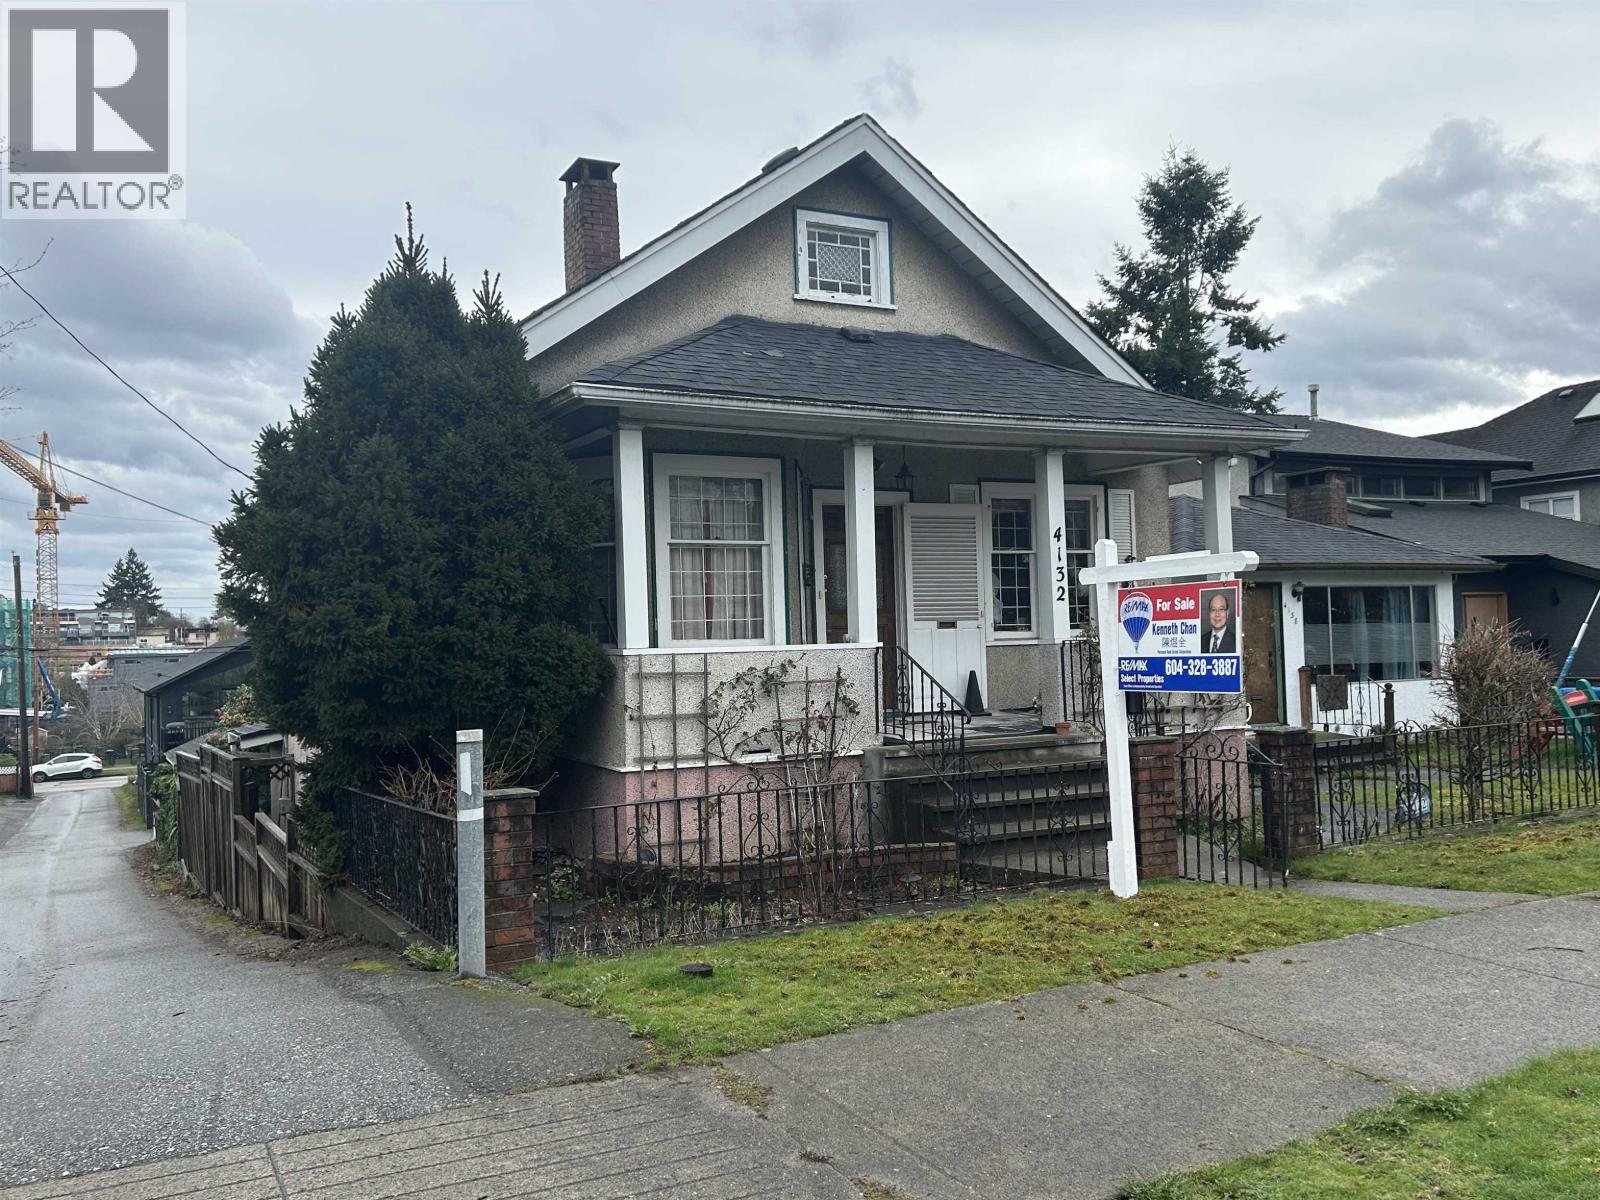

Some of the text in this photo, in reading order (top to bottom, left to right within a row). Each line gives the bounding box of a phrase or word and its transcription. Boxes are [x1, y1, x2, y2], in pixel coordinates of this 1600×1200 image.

[1053, 526, 1066, 602] 4132
[1124, 599, 1149, 613] RE/MAX
[1156, 597, 1195, 612] For Sale
[1152, 620, 1197, 636] Kenneth Chan
[1120, 659, 1148, 671] RE/MAX
[1165, 658, 1238, 676] 604-328-3887
[1120, 673, 1165, 684] Select Properties
